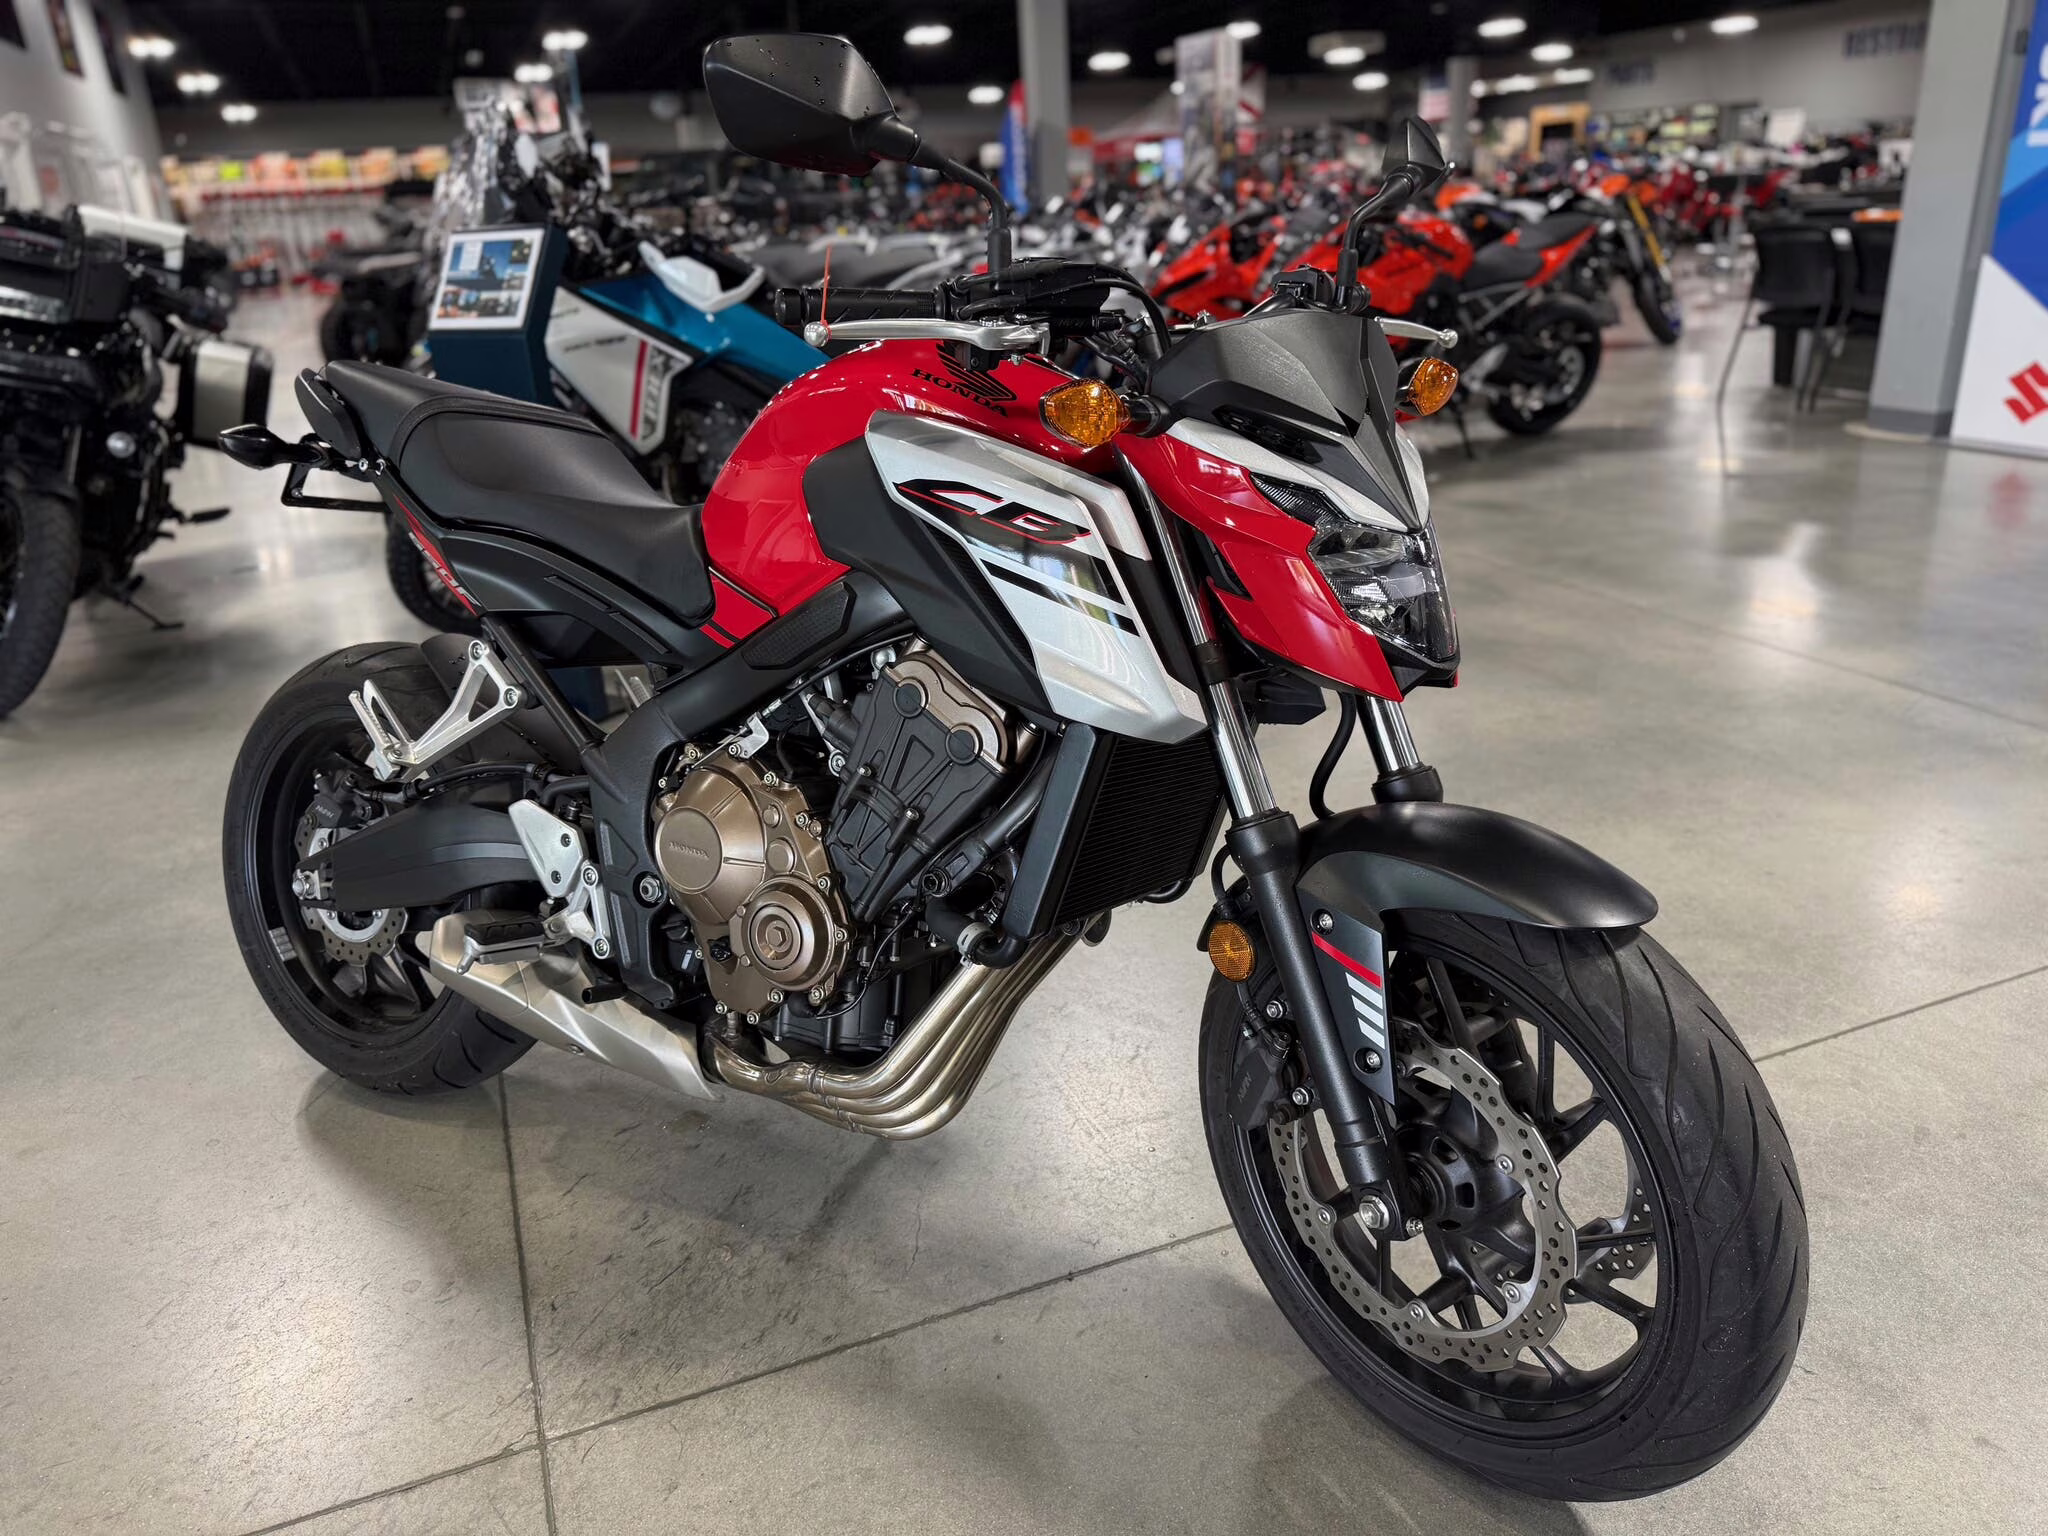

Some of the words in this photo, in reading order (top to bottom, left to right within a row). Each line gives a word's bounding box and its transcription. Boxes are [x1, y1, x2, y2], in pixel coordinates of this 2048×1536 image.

[911, 368, 1009, 417] HONDA
[893, 478, 1092, 545] CB
[669, 840, 711, 860] HONDA
